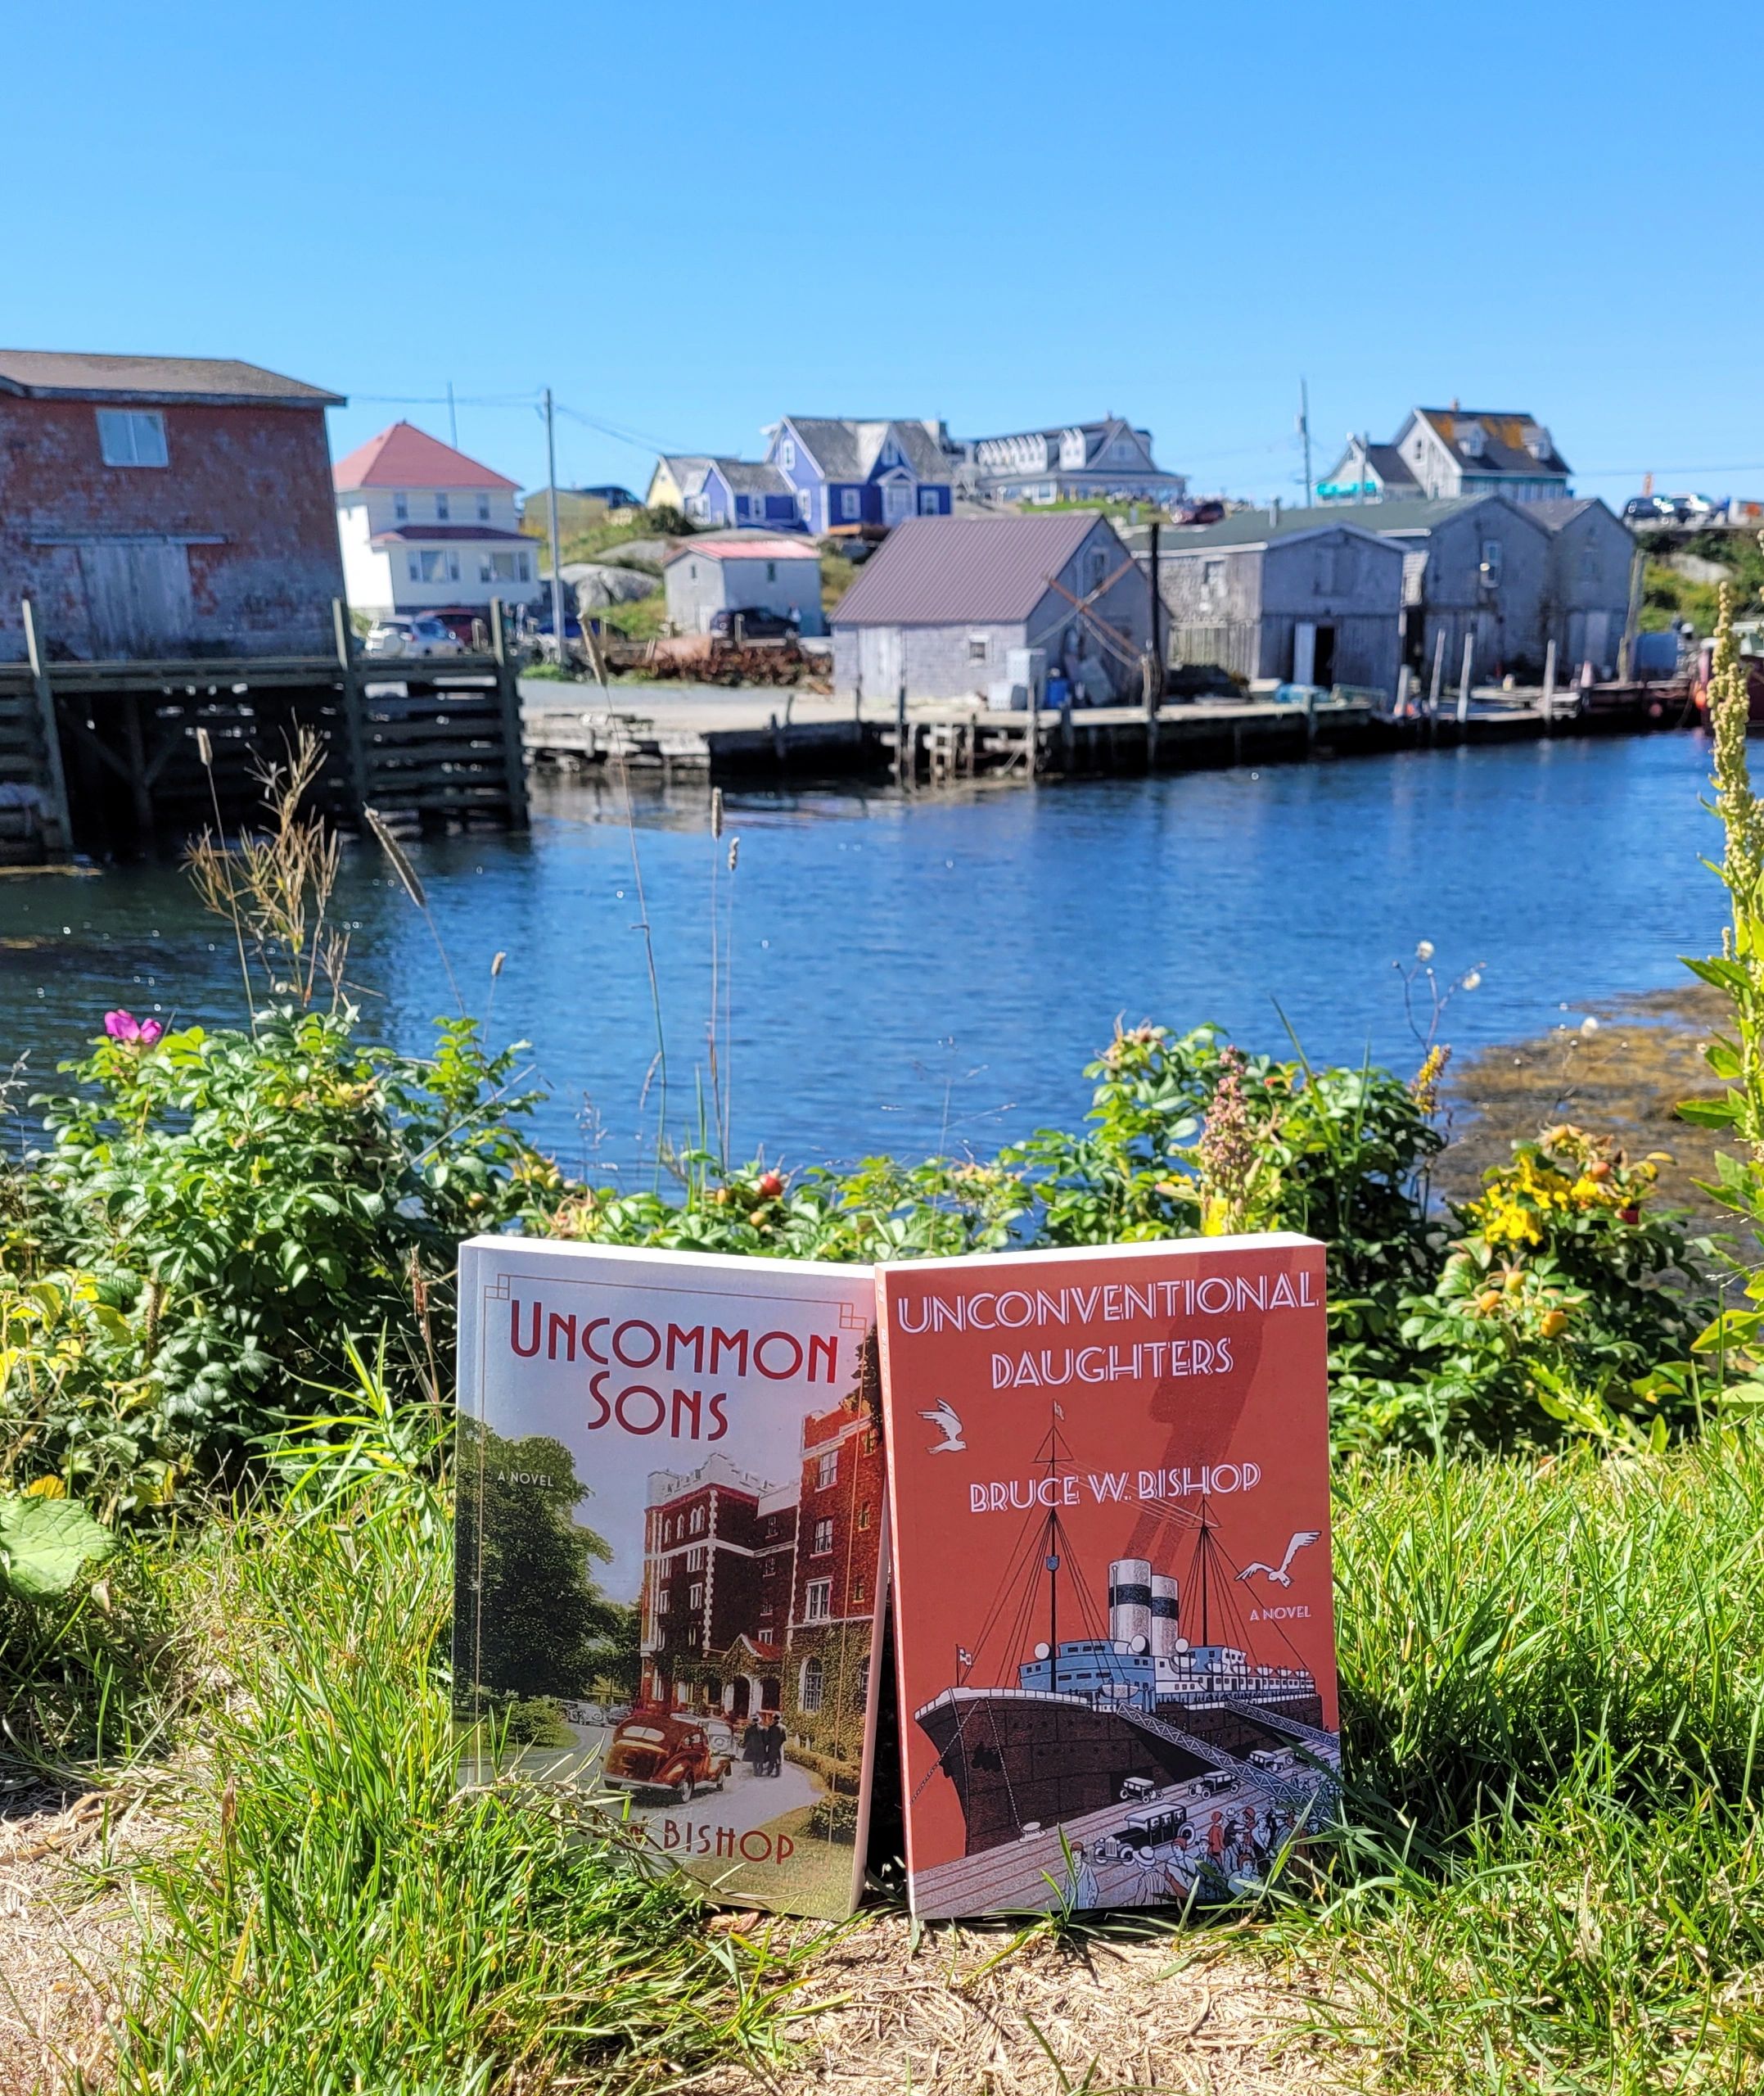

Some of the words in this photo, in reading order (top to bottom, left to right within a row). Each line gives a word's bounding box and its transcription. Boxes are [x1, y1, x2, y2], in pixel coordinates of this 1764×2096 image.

[897, 1271, 1320, 1335] UNCONVENTIONAL
[510, 1299, 838, 1385] UNCOMMON
[990, 1337, 1234, 1389] DAUGHTERS
[587, 1370, 729, 1442] SONS
[497, 1470, 506, 1482] A
[510, 1470, 555, 1488] NOVEL
[969, 1475, 1081, 1513] BRUCE
[1087, 1471, 1132, 1504] W.
[1138, 1461, 1262, 1500] BISHOP
[1249, 1608, 1261, 1622] A
[1262, 1605, 1312, 1621] NOVEL
[664, 1818, 794, 1865] BISHOP
